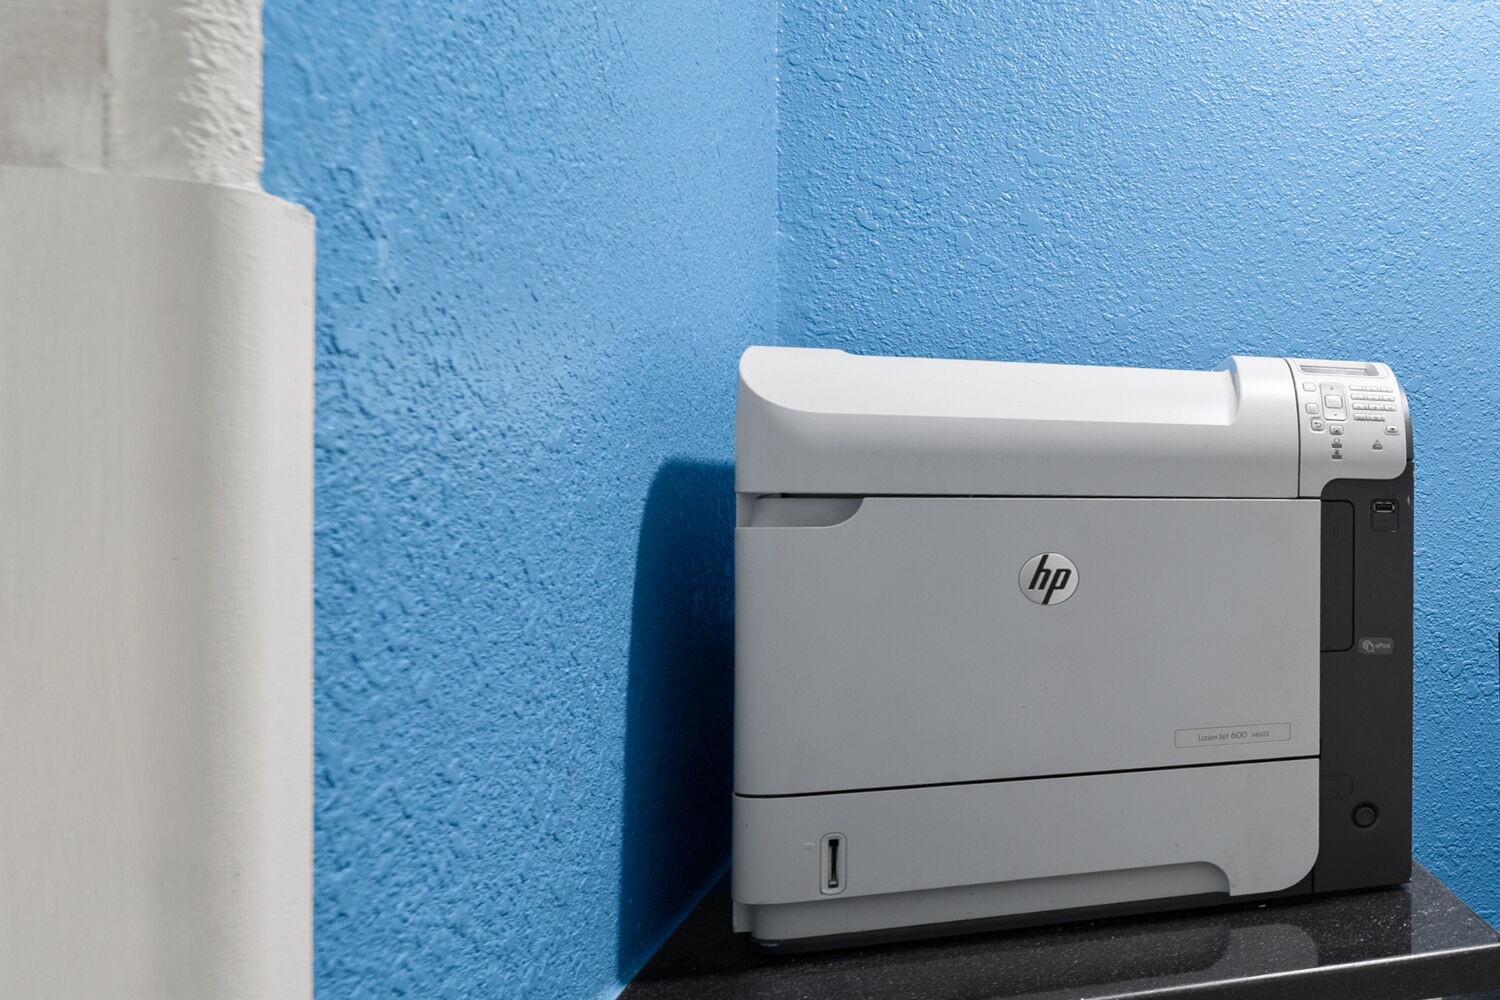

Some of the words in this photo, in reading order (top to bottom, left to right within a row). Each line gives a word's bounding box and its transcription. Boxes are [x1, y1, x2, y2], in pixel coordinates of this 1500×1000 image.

[1028, 554, 1072, 605] hp
[1198, 732, 1229, 742] LaserJet
[1230, 730, 1248, 740] 600
